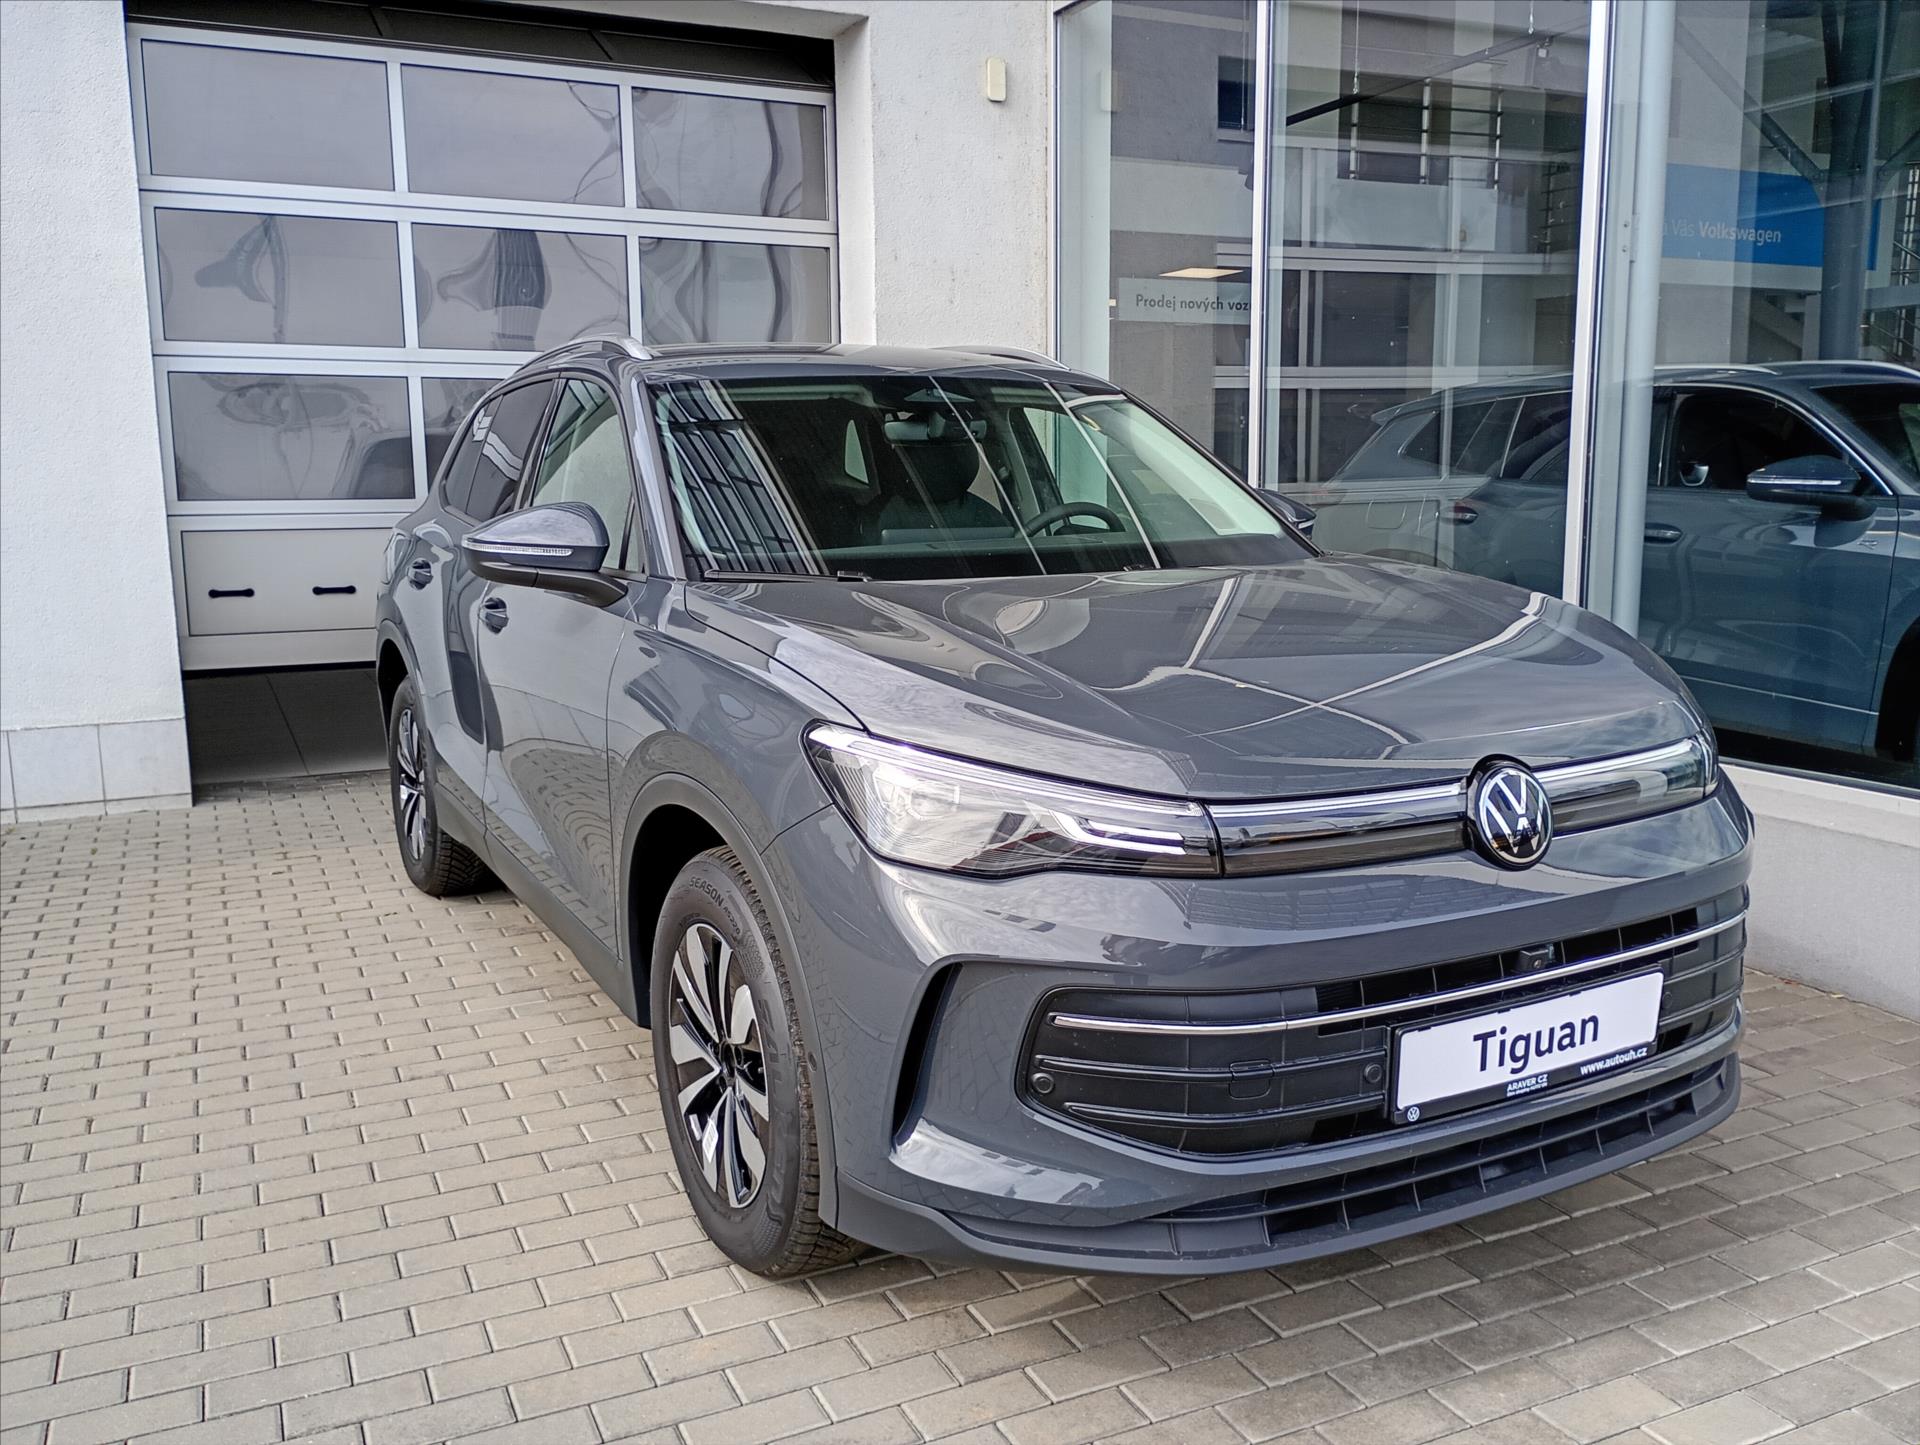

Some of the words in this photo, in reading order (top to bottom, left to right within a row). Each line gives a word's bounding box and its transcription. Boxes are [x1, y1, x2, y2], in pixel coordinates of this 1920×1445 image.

[1699, 221, 1782, 246] Volkswagen
[1135, 293, 1176, 312] Prodej
[1180, 297, 1224, 312] nových
[1227, 301, 1251, 312] voz
[689, 876, 725, 907] SEASON
[1473, 1014, 1599, 1075] Tiguan
[1580, 1047, 1648, 1076] www.autouh.cz
[1506, 1077, 1537, 1092] ARAVER
[1537, 1073, 1548, 1083] CZ
